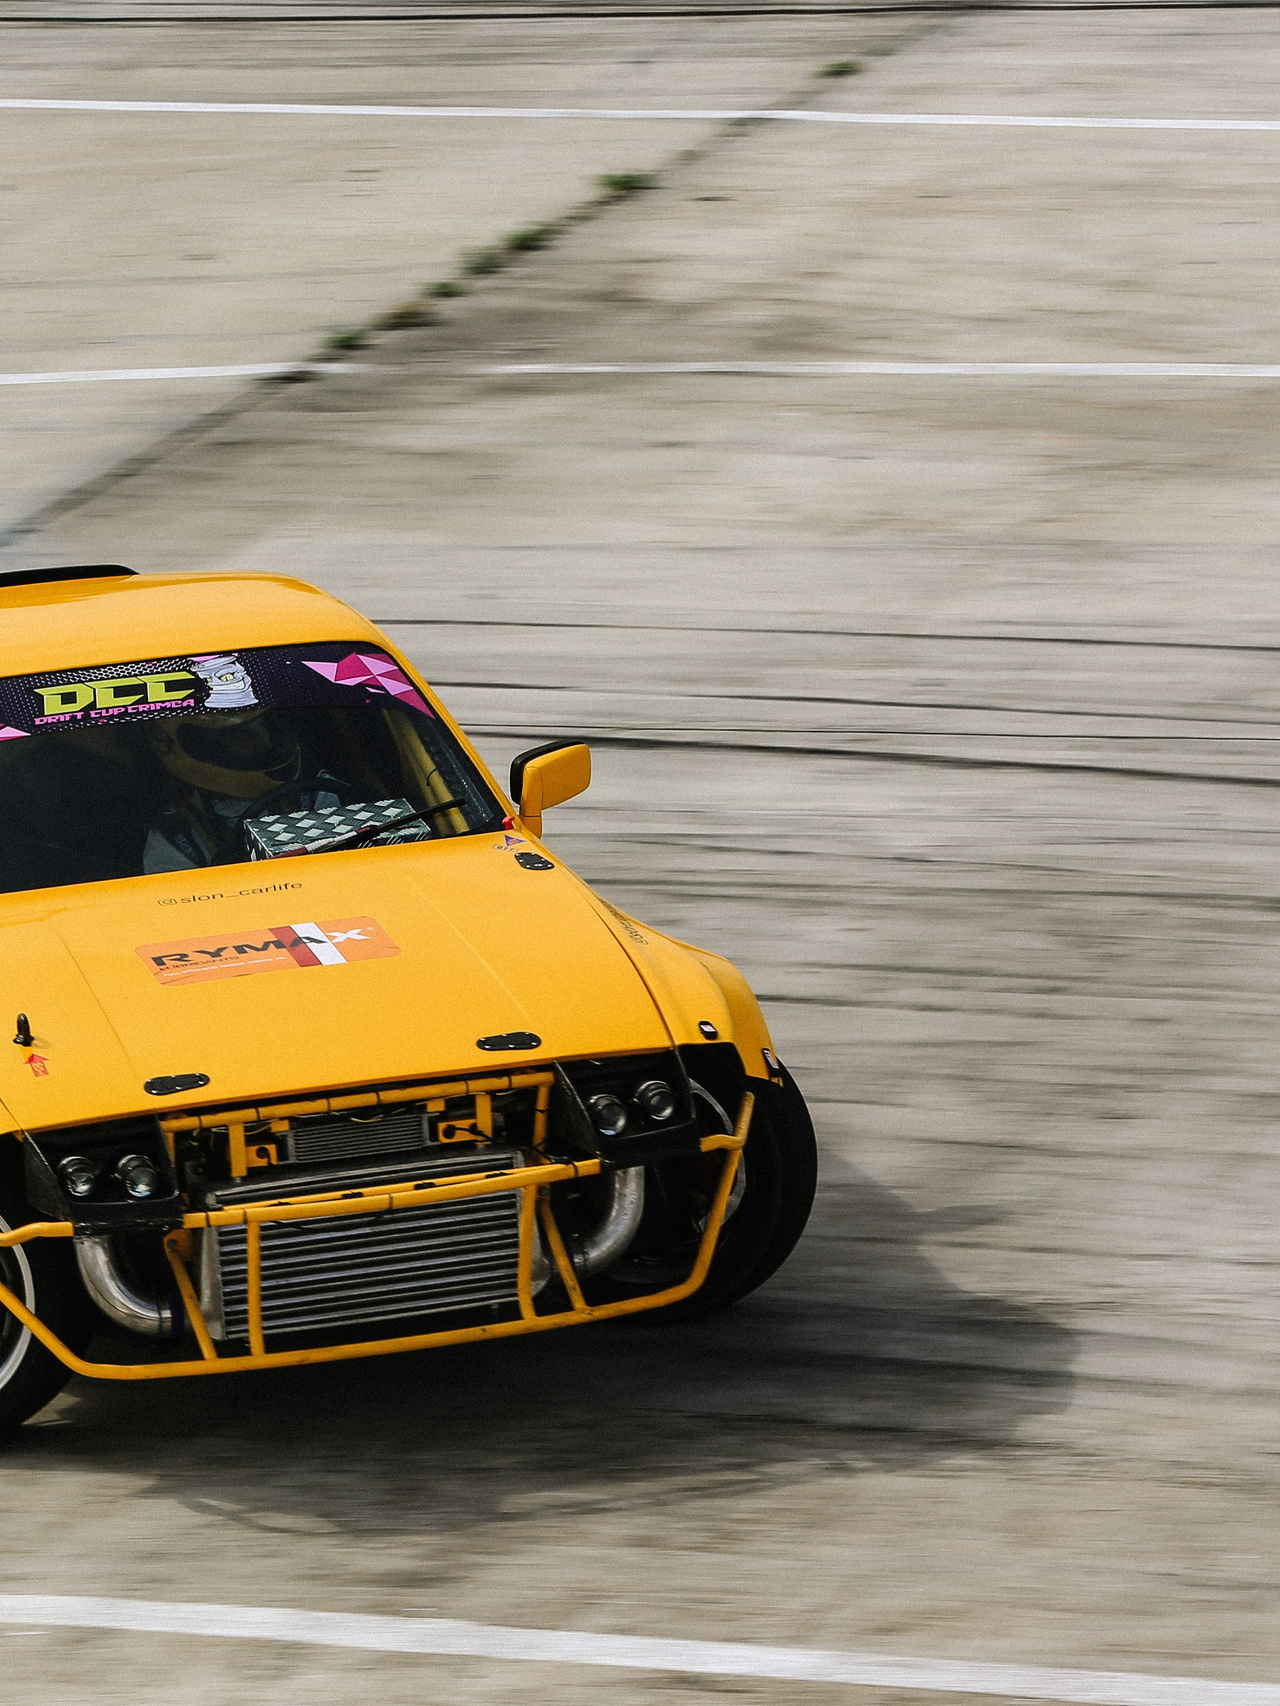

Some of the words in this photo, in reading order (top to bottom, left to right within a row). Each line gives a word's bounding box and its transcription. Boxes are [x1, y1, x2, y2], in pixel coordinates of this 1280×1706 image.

[34, 671, 196, 716] DCC
[33, 711, 85, 726] DRIFT
[89, 707, 125, 718] CUP
[150, 928, 371, 967] RYMAX
